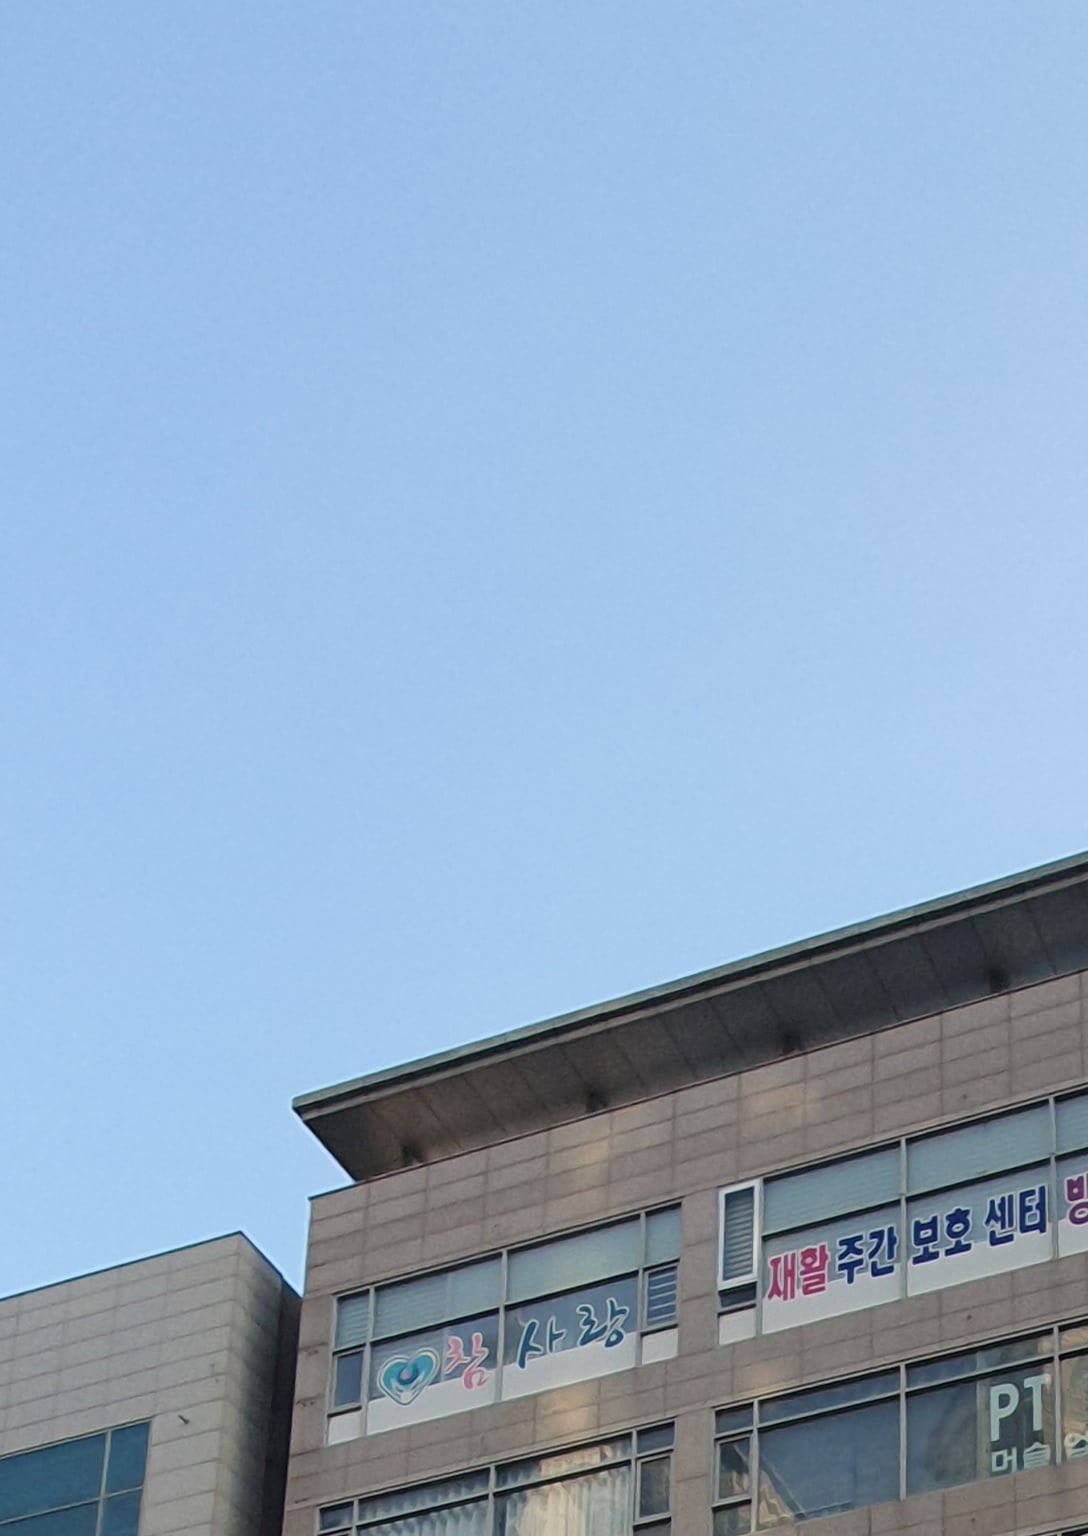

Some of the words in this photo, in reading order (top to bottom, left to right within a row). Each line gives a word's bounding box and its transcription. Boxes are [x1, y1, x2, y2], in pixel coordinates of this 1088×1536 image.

[766, 1244, 830, 1302] 재활
[836, 1227, 898, 1286] 주간
[911, 1206, 973, 1266] 보호
[983, 1184, 1049, 1248] 센터
[988, 1374, 1051, 1444] PT
